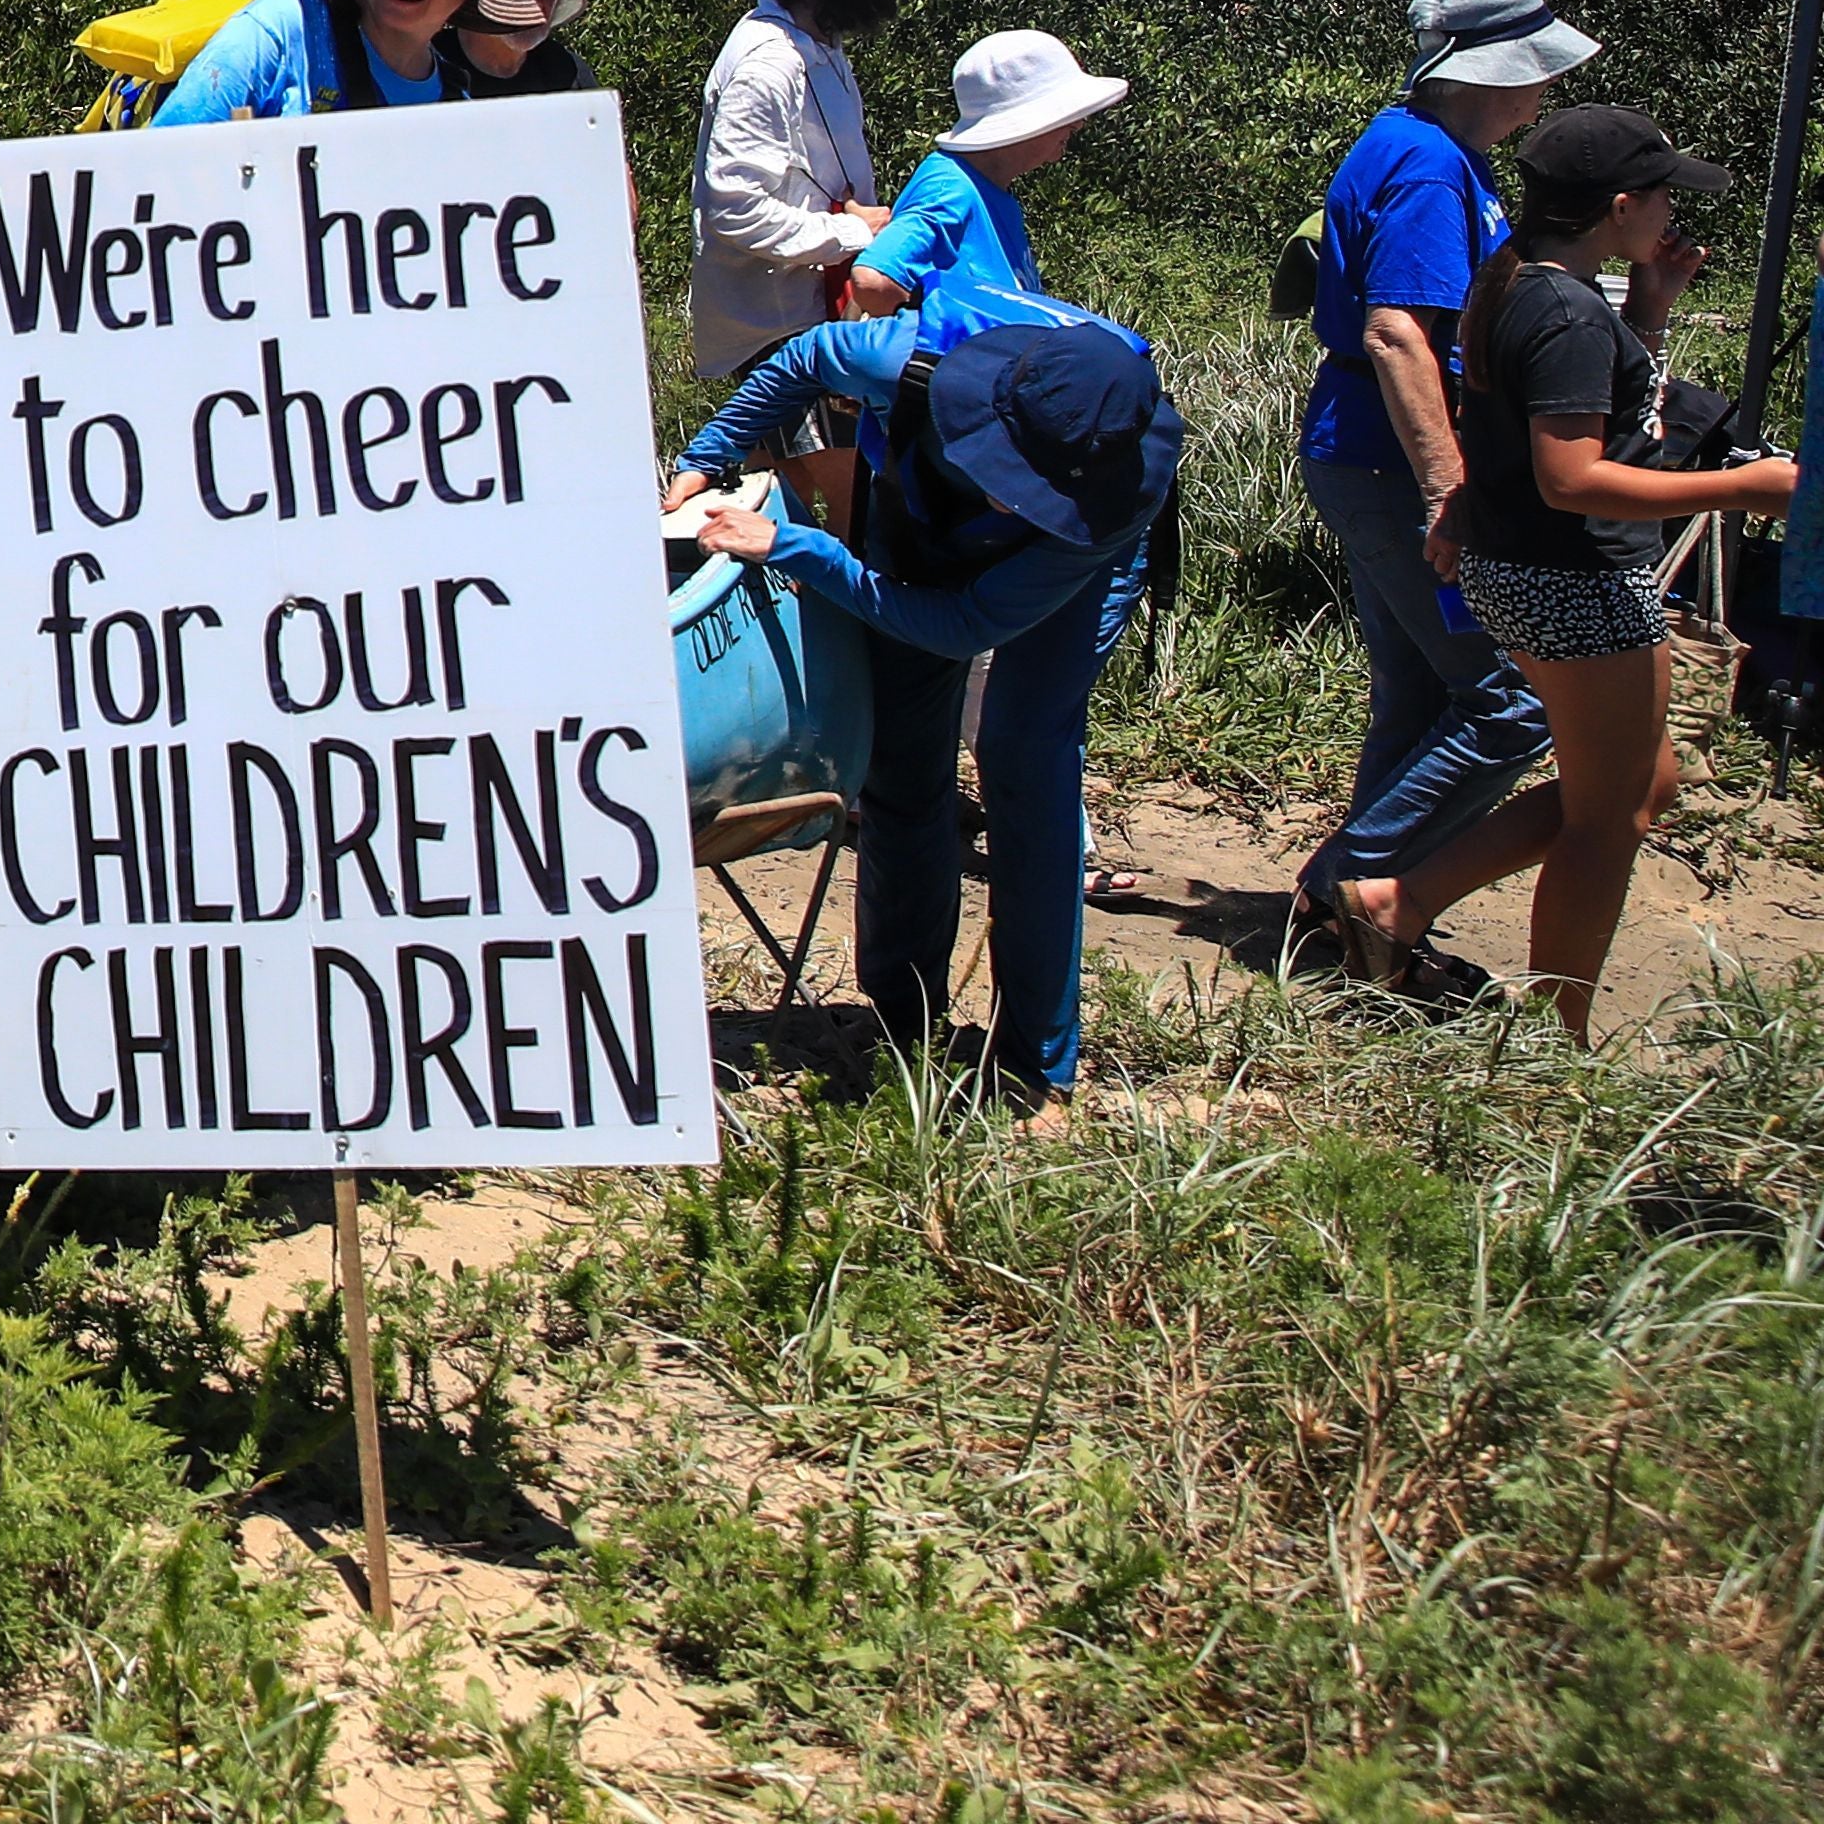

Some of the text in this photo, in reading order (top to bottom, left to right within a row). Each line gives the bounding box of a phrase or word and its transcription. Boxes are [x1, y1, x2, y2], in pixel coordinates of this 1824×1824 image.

[298, 146, 561, 318] here
[13, 338, 570, 534] to cheer
[38, 553, 510, 731] for our
[0, 717, 659, 925] CHILDREN'S
[37, 934, 658, 1133] CHILDREN
